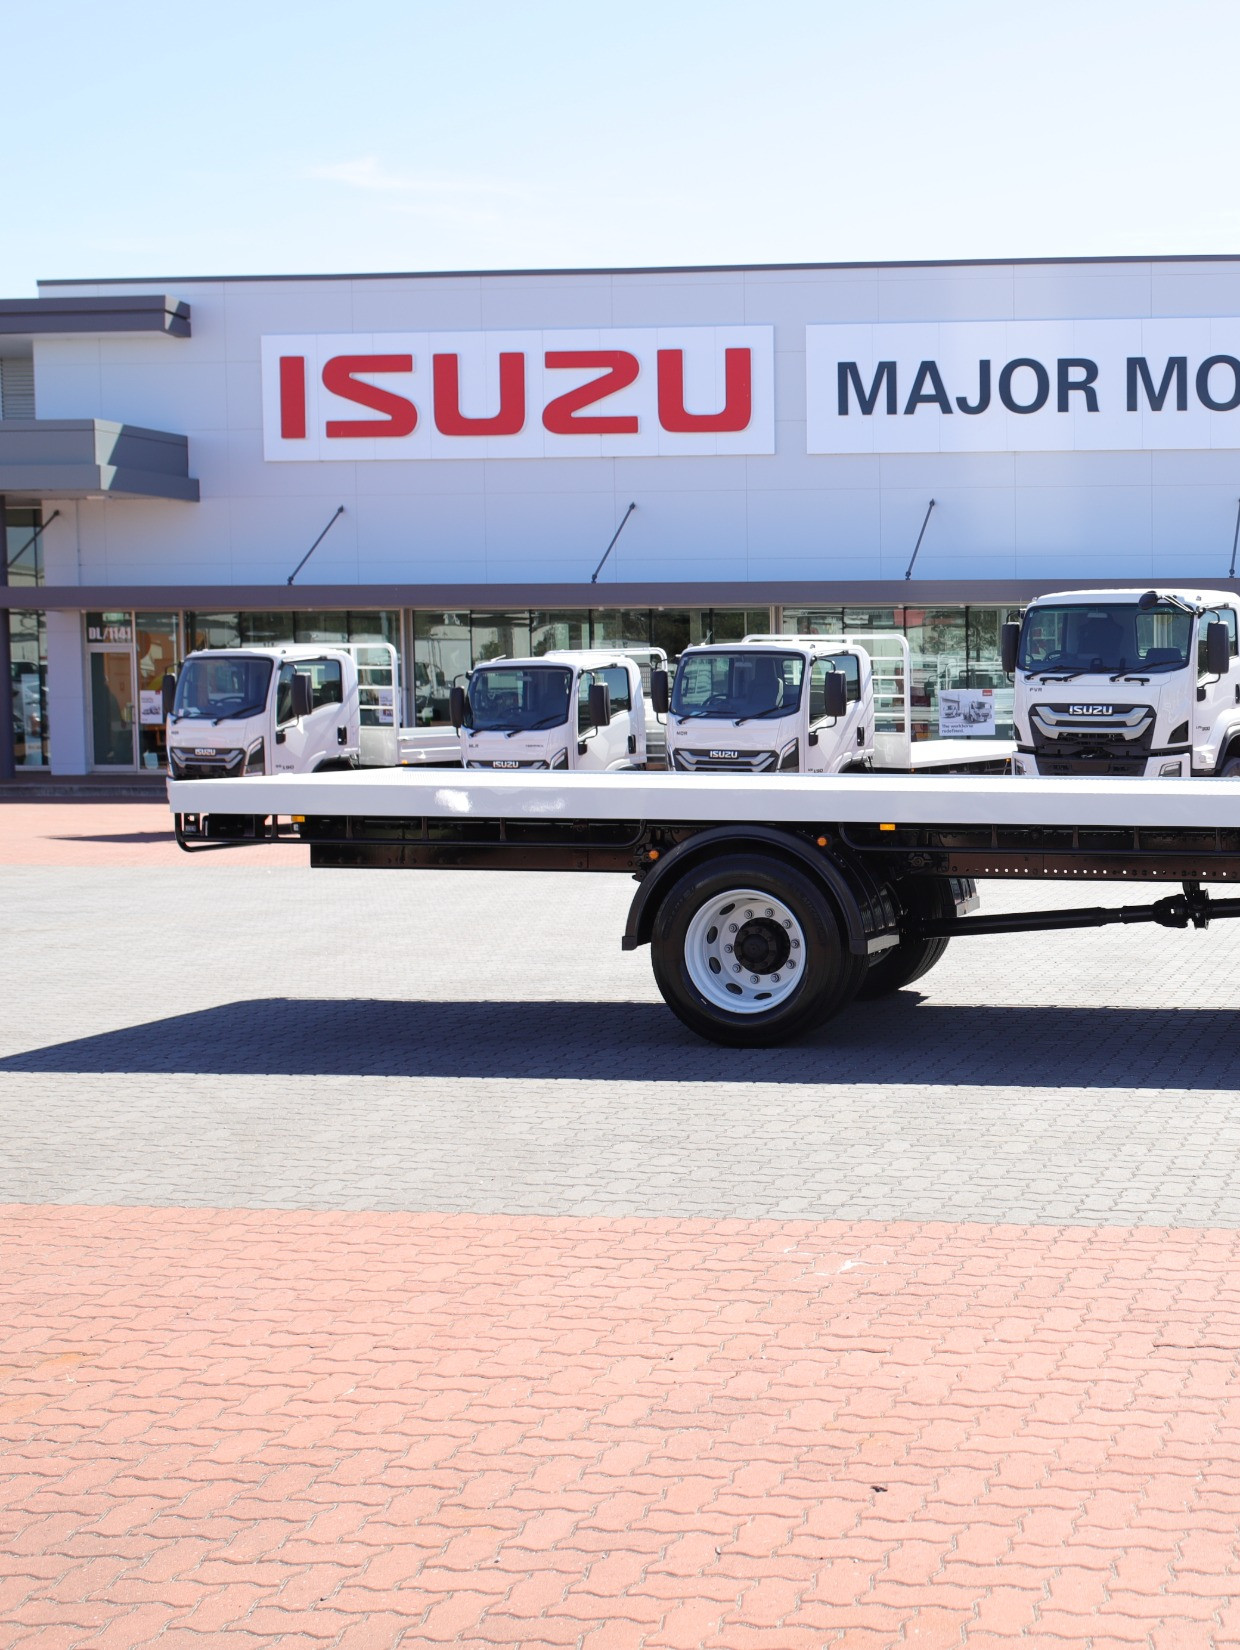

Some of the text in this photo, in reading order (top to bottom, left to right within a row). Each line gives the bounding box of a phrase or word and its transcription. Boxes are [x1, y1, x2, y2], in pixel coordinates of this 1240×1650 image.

[836, 357, 1100, 416] MAJOR
[279, 348, 752, 439] ISUZU
[1069, 705, 1113, 715] ISUZU
[194, 748, 217, 756] ISUZU
[709, 750, 738, 759] ISUZU
[492, 760, 519, 769] ISUZU
